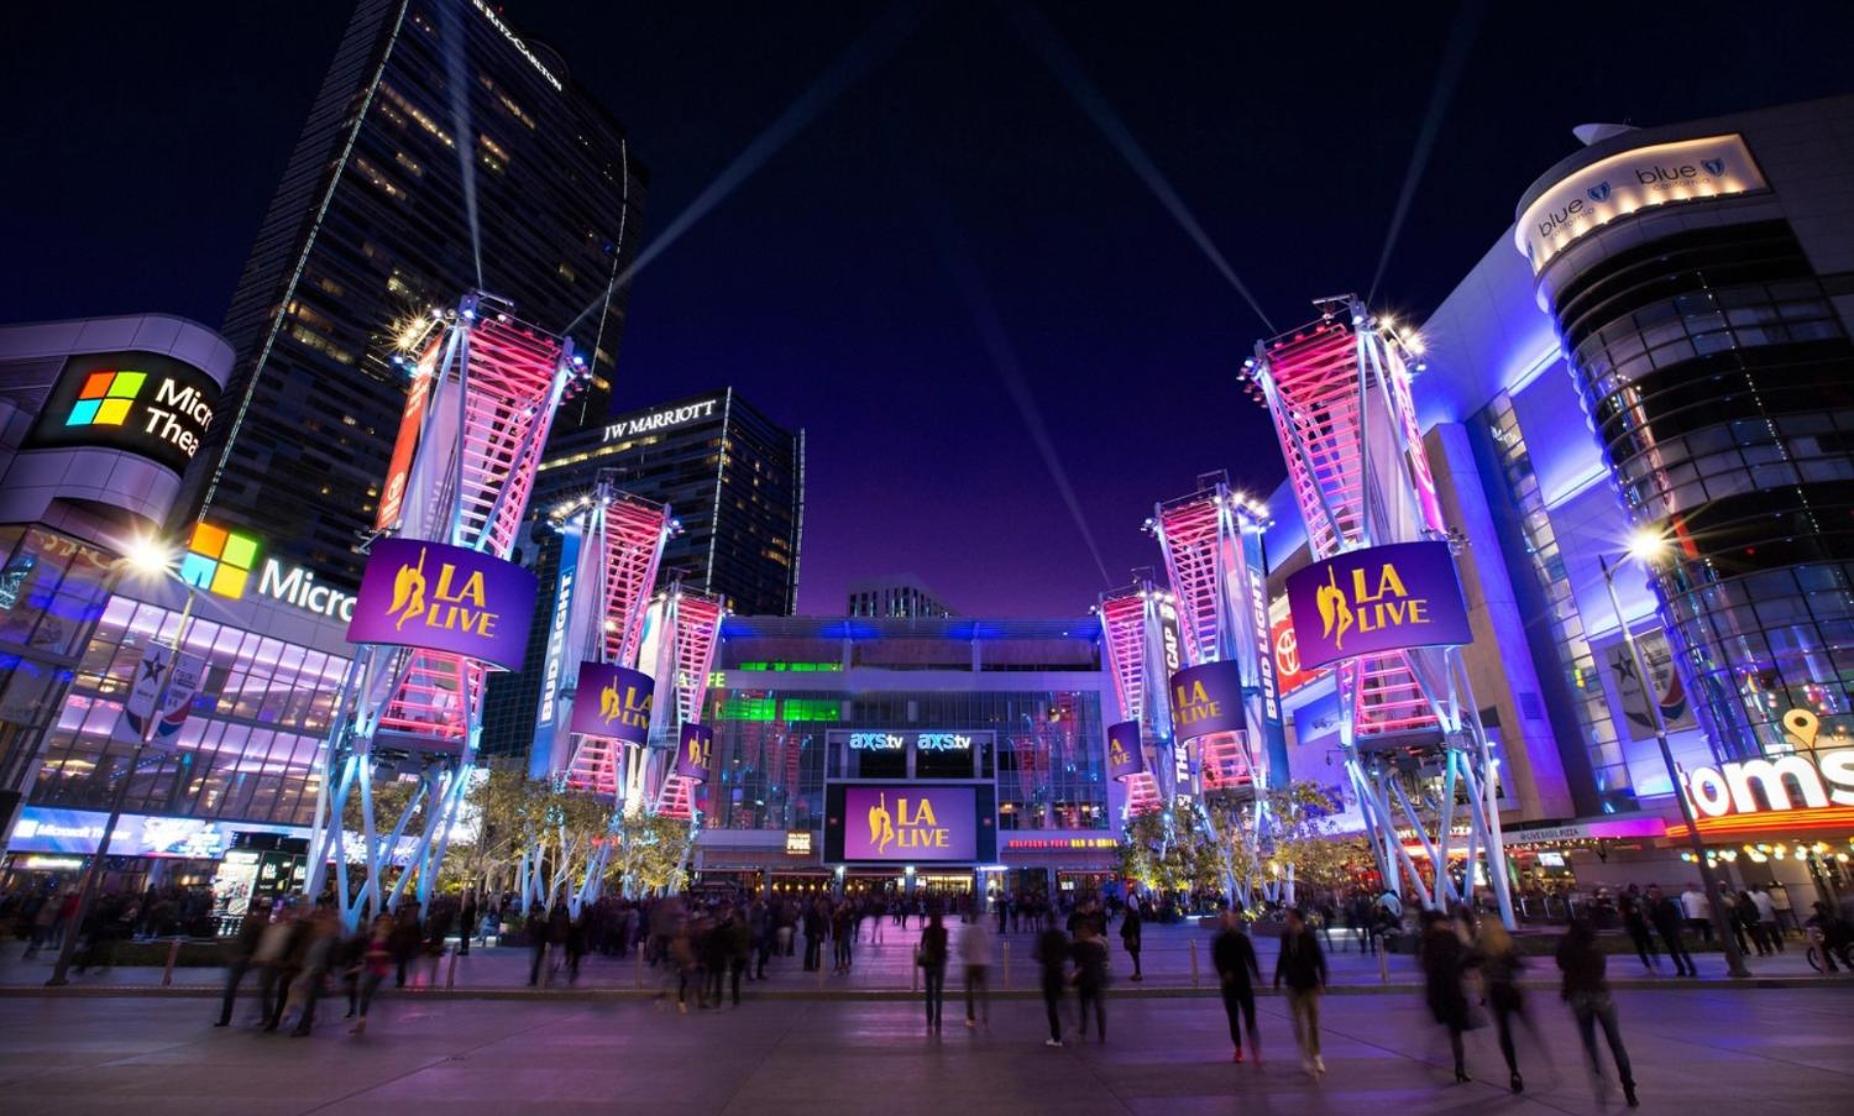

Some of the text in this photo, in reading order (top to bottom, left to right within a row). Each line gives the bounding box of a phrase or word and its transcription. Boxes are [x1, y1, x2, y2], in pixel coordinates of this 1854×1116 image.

[1635, 164, 1697, 184] blue
[1539, 199, 1583, 238] blue
[603, 400, 716, 442] JW MARRIOTT
[433, 563, 486, 608] LA
[1352, 563, 1409, 604] LA
[425, 603, 499, 638] LIVE
[1357, 599, 1431, 633] LIVE
[541, 573, 573, 721] BUD LIGHT
[1250, 570, 1278, 719] BUD LIGHT
[1176, 680, 1210, 709] LA
[1181, 702, 1223, 725] LIVE
[897, 798, 937, 826] LA
[897, 828, 950, 848] LIVE
